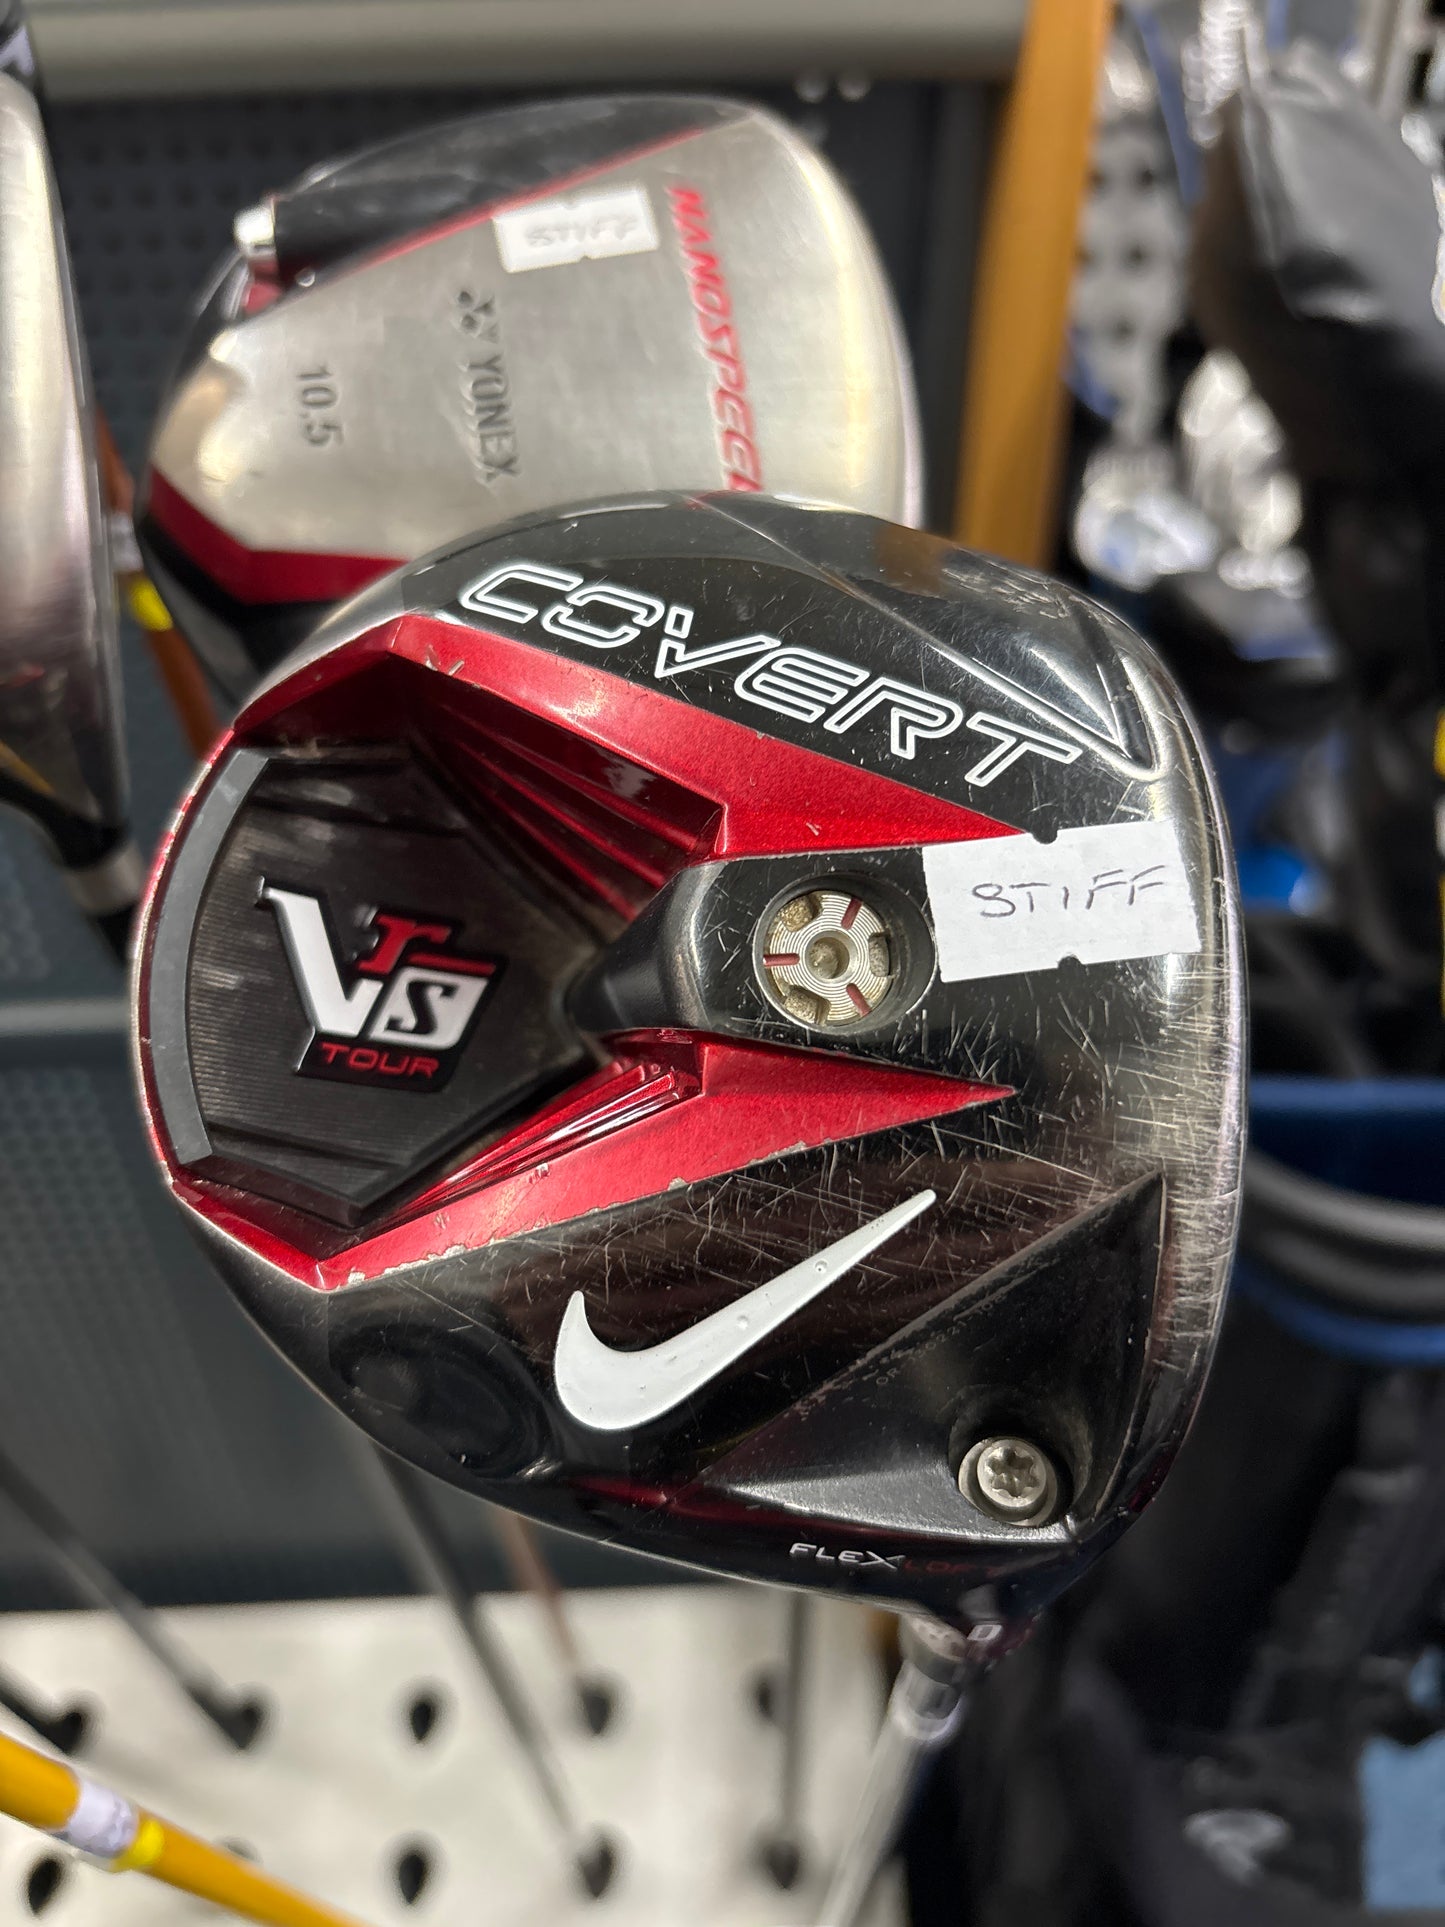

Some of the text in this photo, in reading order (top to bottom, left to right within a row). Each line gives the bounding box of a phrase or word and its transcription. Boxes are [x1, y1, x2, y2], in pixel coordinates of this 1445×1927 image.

[297, 364, 343, 447] 10.5
[467, 352, 520, 483] YONEX
[459, 563, 1084, 788] COVERT
[971, 864, 1167, 918] STIFF
[321, 1042, 441, 1080] TOUR
